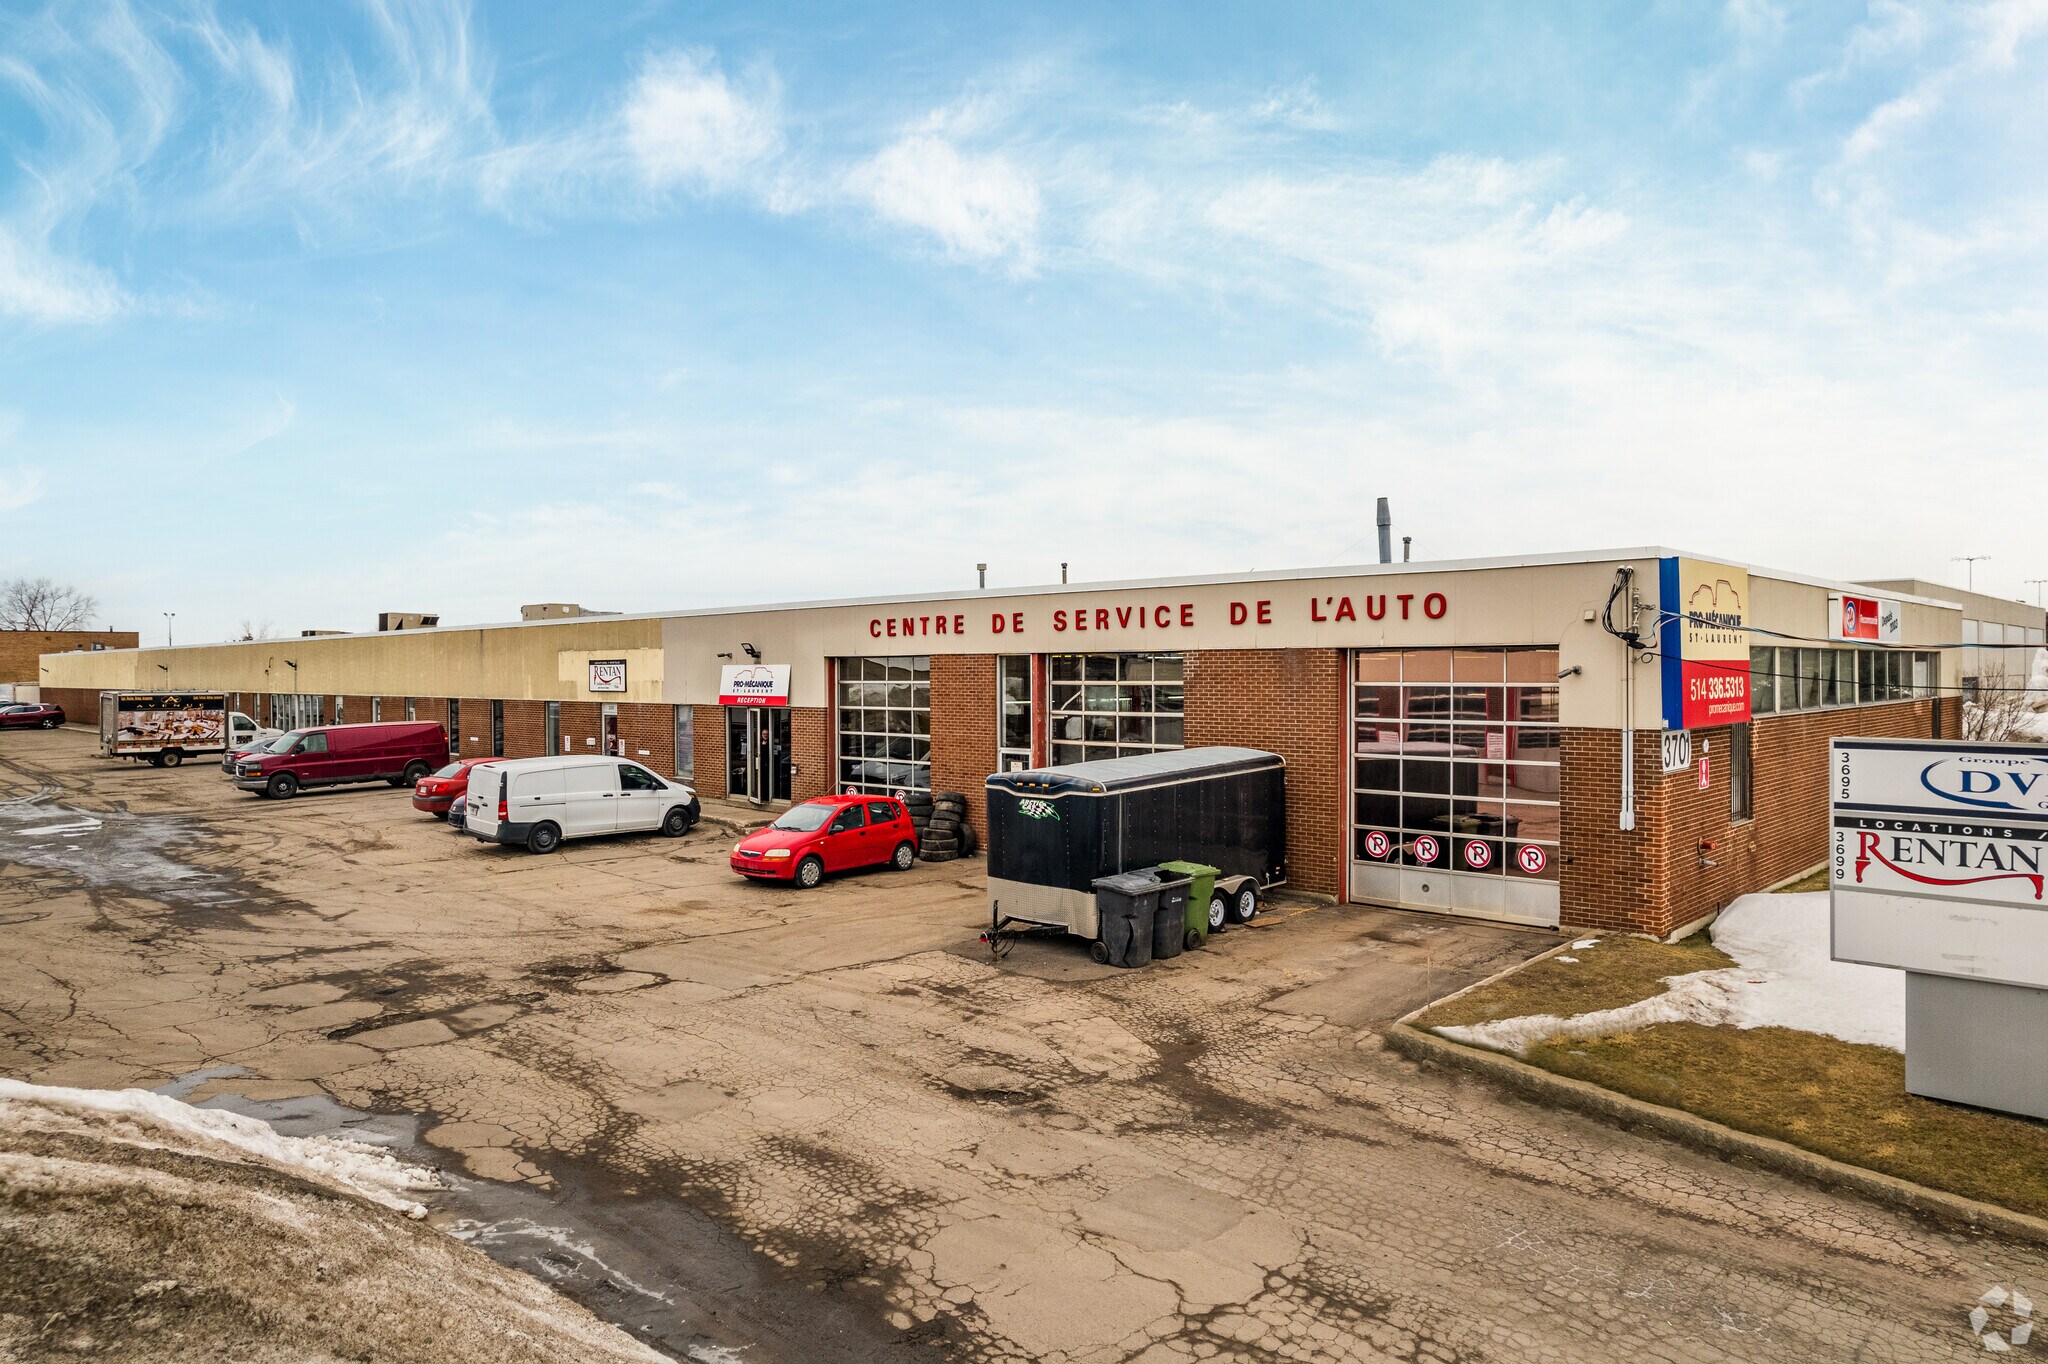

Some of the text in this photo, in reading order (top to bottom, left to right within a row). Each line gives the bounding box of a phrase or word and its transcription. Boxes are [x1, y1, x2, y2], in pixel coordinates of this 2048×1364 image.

[869, 592, 1447, 638] CENTRE DE SERVICE DE L'AUTO
[1689, 633, 1742, 644] ST-LAURENT
[593, 665, 622, 678] RENTAN
[733, 679, 774, 689] PRO-MÉCANIQUE
[1690, 676, 1744, 701] 514 336.5313
[1708, 701, 1745, 717] promecanique.com
[1664, 732, 1690, 768] 3701
[1958, 756, 2031, 767] Groupe
[1841, 752, 1850, 799] 3695
[1958, 769, 2048, 798] DV
[1859, 819, 2013, 838] LOCATIONS
[1836, 831, 1845, 880] 3699
[1856, 831, 2043, 875] RENTAN
